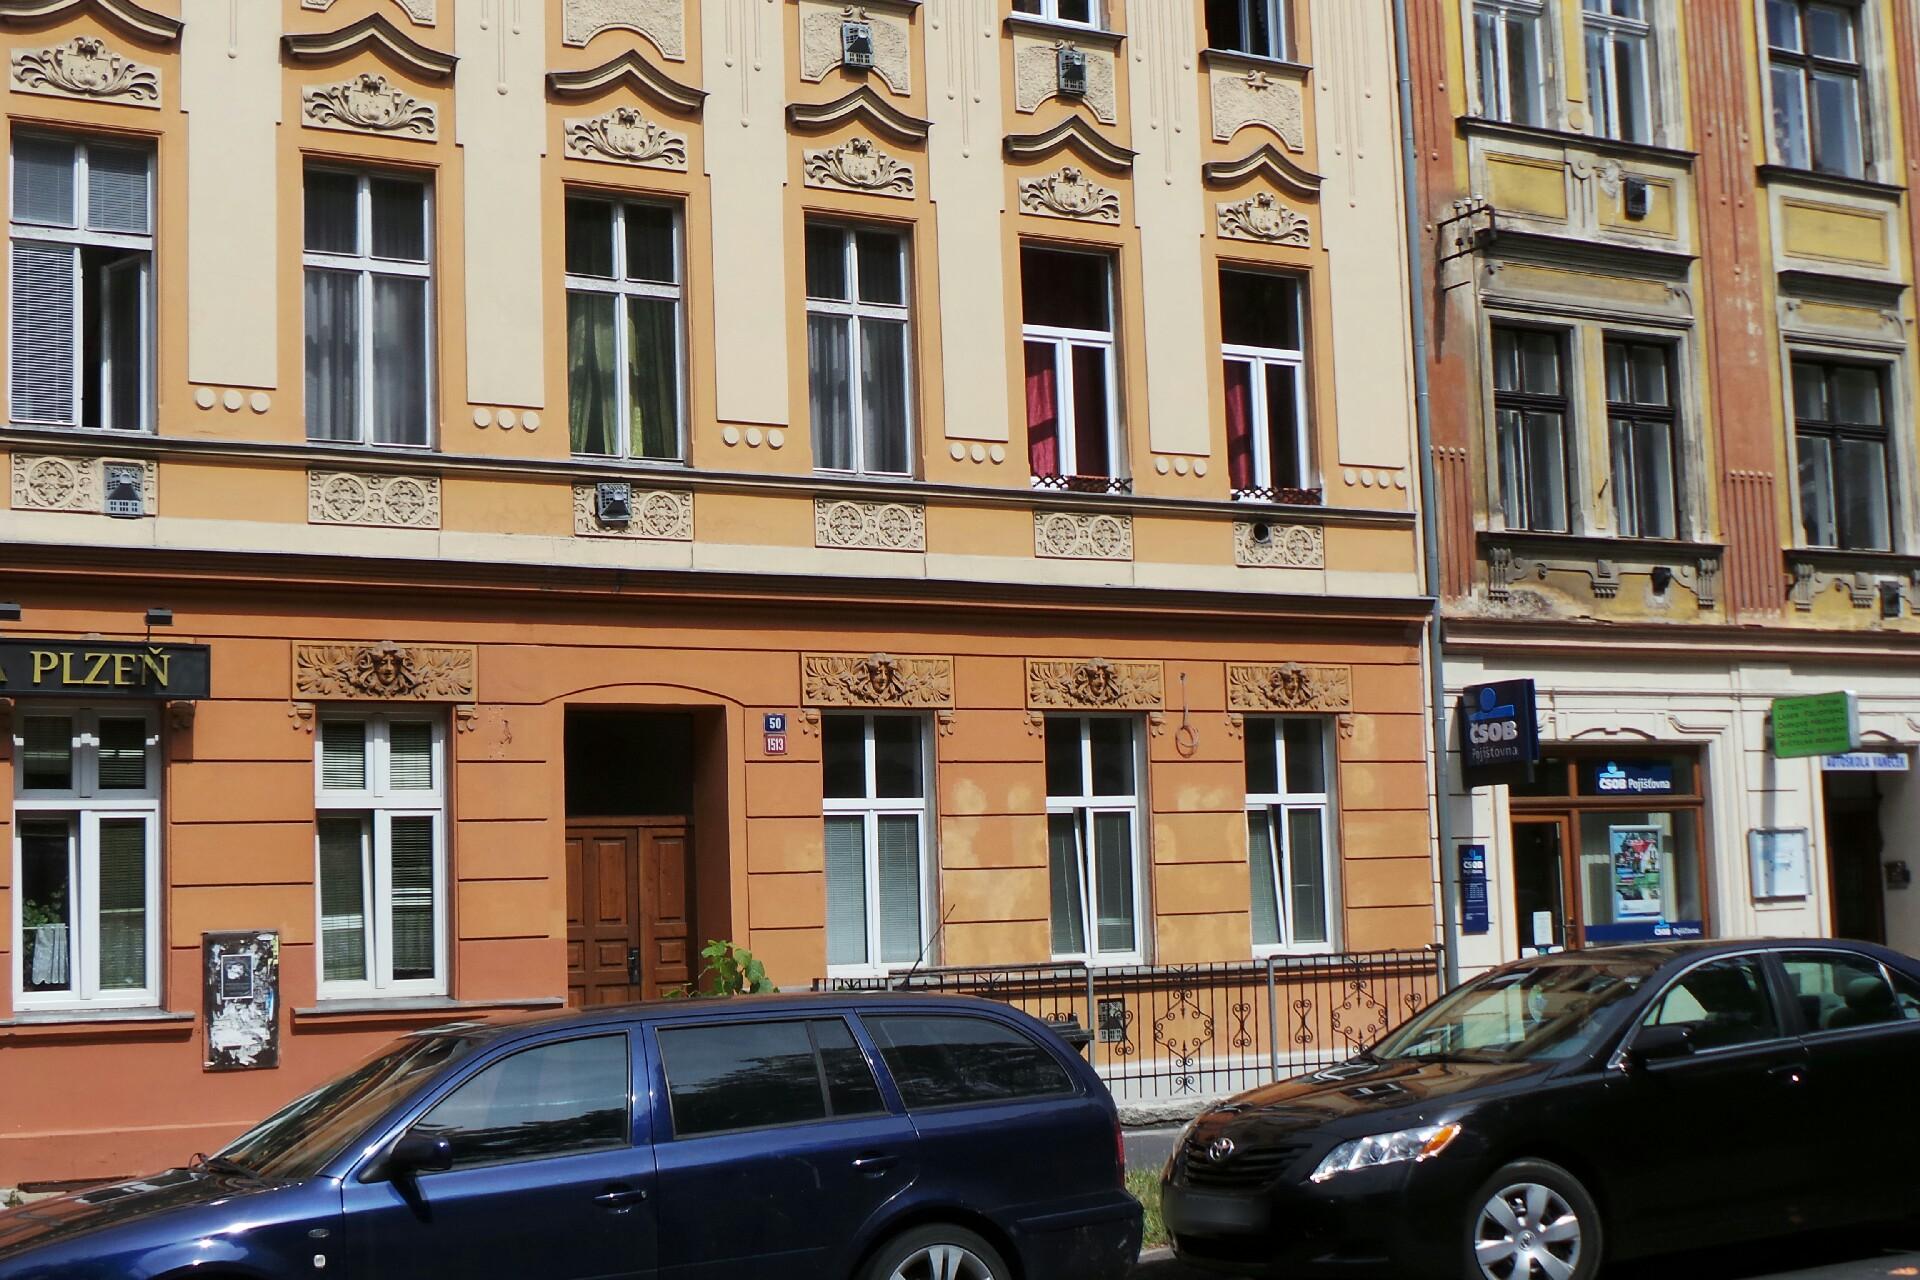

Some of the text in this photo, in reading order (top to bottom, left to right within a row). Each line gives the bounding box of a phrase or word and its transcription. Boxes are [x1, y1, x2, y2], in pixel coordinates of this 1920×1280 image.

[30, 646, 171, 687] PLZEŇ
[769, 717, 782, 729] 50
[1470, 720, 1518, 744] ČSOB
[767, 738, 784, 751] 1513
